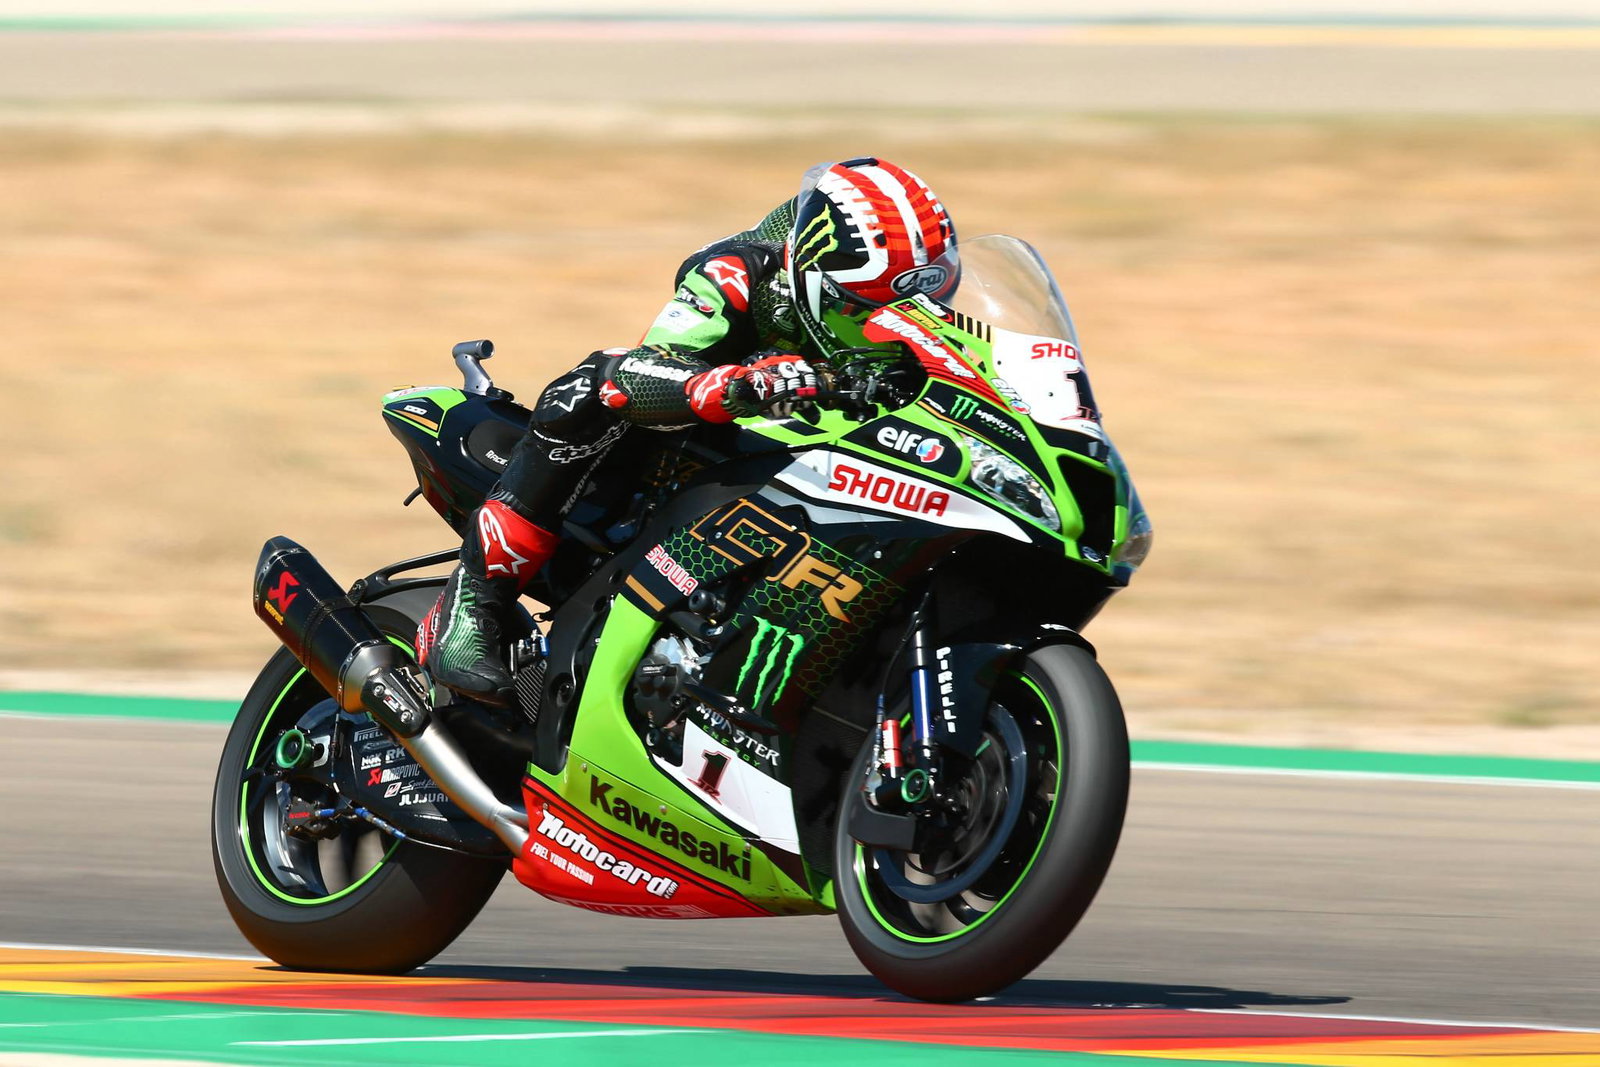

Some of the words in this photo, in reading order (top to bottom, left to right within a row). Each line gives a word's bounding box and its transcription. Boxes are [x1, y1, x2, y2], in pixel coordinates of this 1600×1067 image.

[618, 357, 695, 382] Kawasak
[1030, 342, 1080, 360] SHO
[877, 426, 922, 454] elf
[828, 464, 950, 517] SHOWA
[645, 544, 698, 596] SHOWA
[936, 646, 957, 733] PIRELLI
[354, 727, 386, 742] PIREL
[701, 750, 732, 792] 1
[590, 774, 751, 881] Kawasaki
[530, 842, 549, 860] FUEL
[549, 852, 568, 871] YOUR
[537, 810, 672, 897] Motocard
